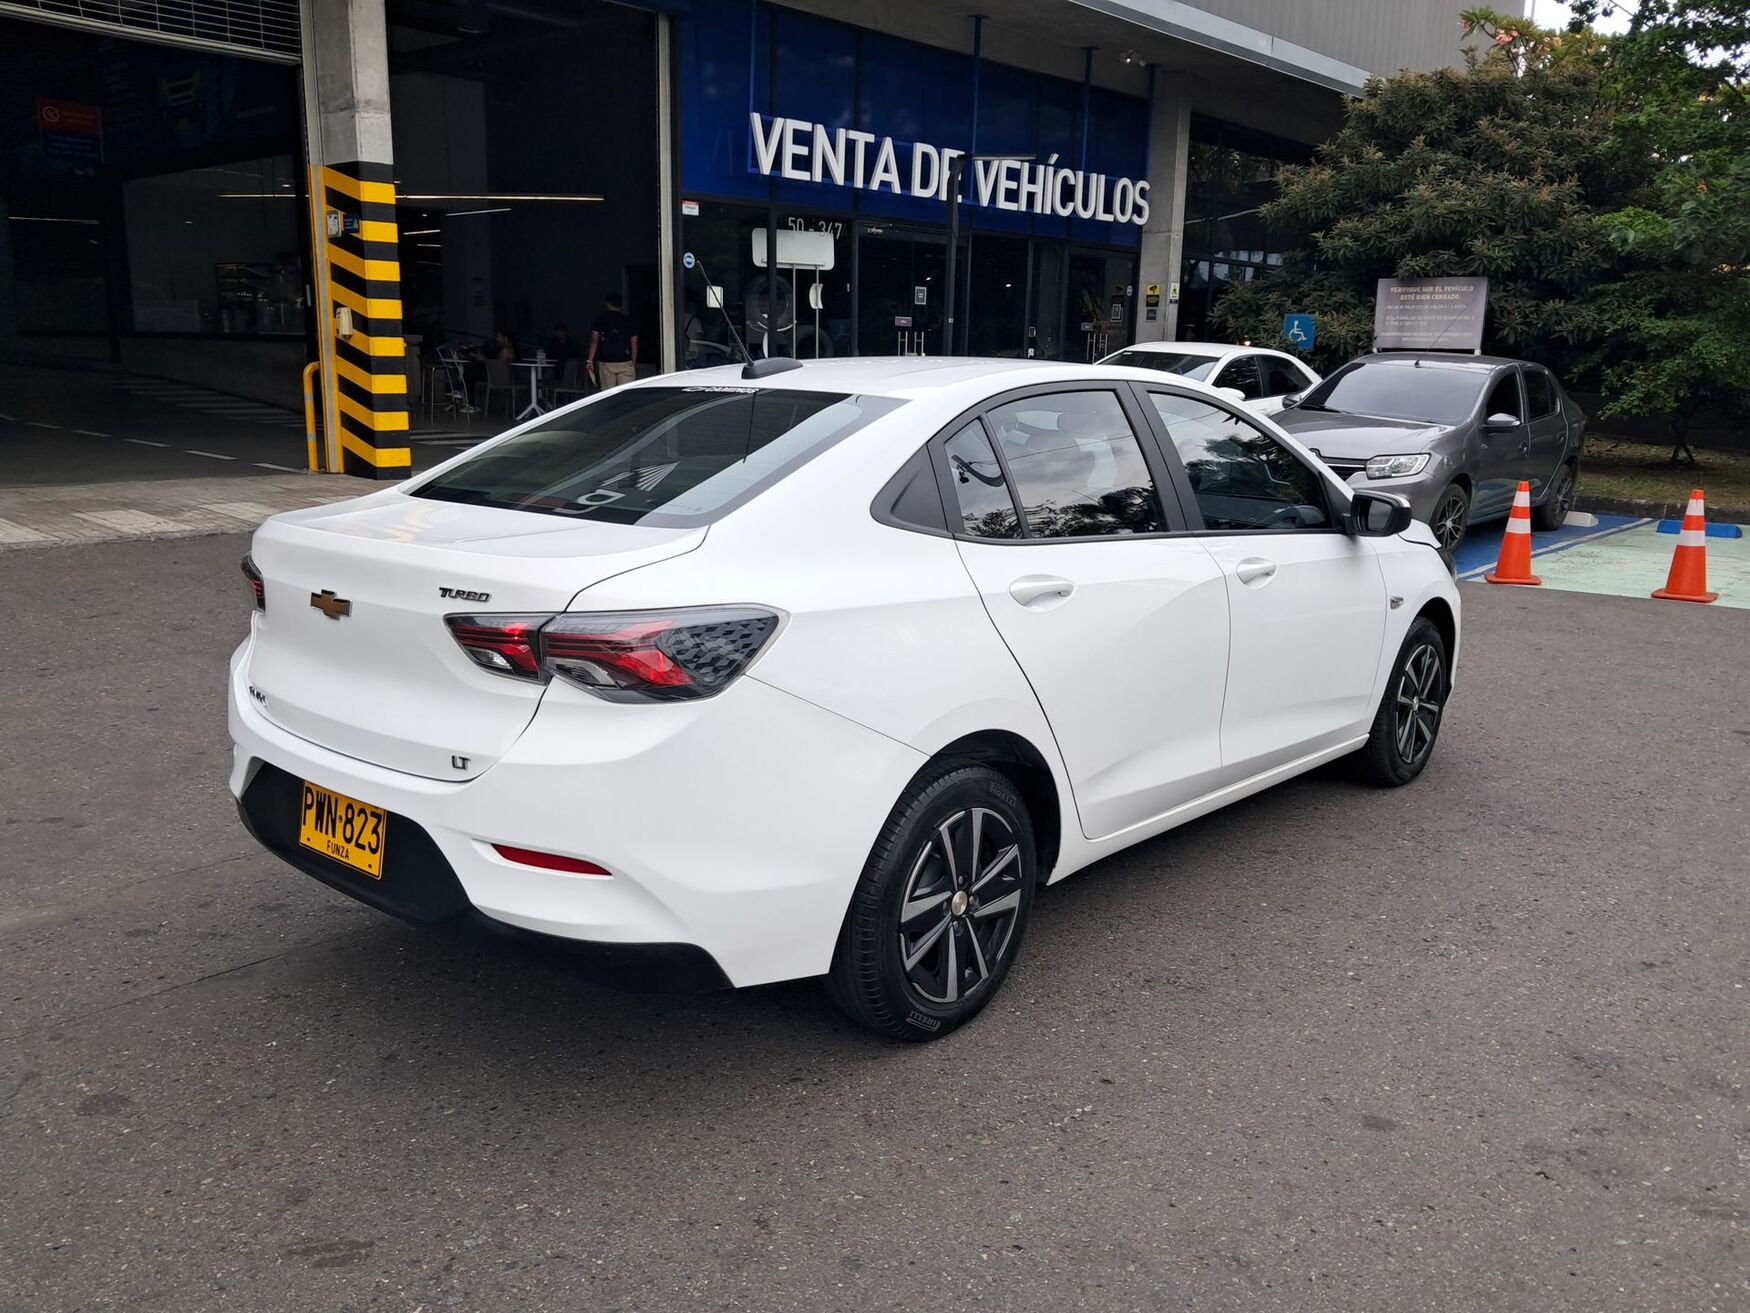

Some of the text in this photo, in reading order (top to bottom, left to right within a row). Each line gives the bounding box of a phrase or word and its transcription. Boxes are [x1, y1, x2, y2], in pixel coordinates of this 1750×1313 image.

[750, 112, 1150, 226] VENTA DE VEHÍCULOS
[438, 586, 492, 602] TURBO
[451, 755, 471, 770] LT
[326, 840, 350, 860] FUNZA
